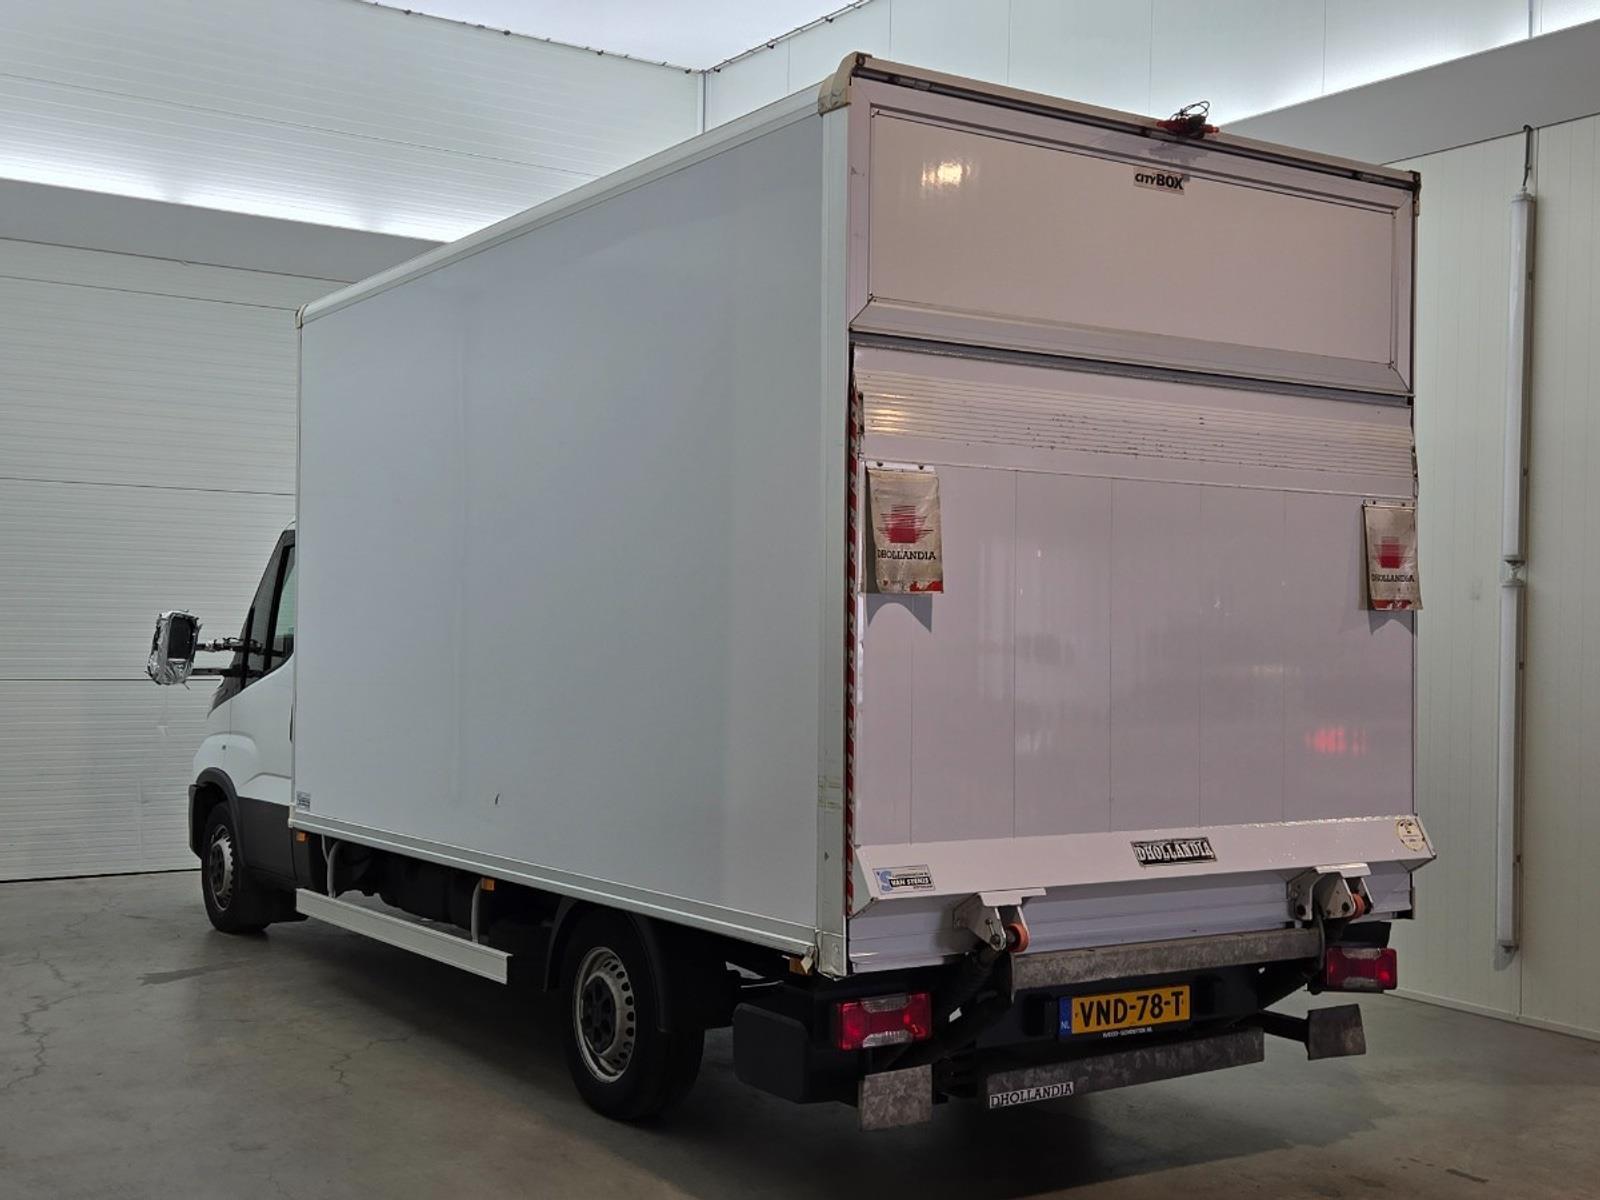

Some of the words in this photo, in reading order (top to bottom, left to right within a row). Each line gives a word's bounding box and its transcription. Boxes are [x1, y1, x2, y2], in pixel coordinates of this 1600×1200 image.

[1134, 840, 1213, 861] DHOLLANDIA
[1080, 991, 1183, 1028] VND-78-T
[991, 1083, 1072, 1106] DHOLLANDIA
